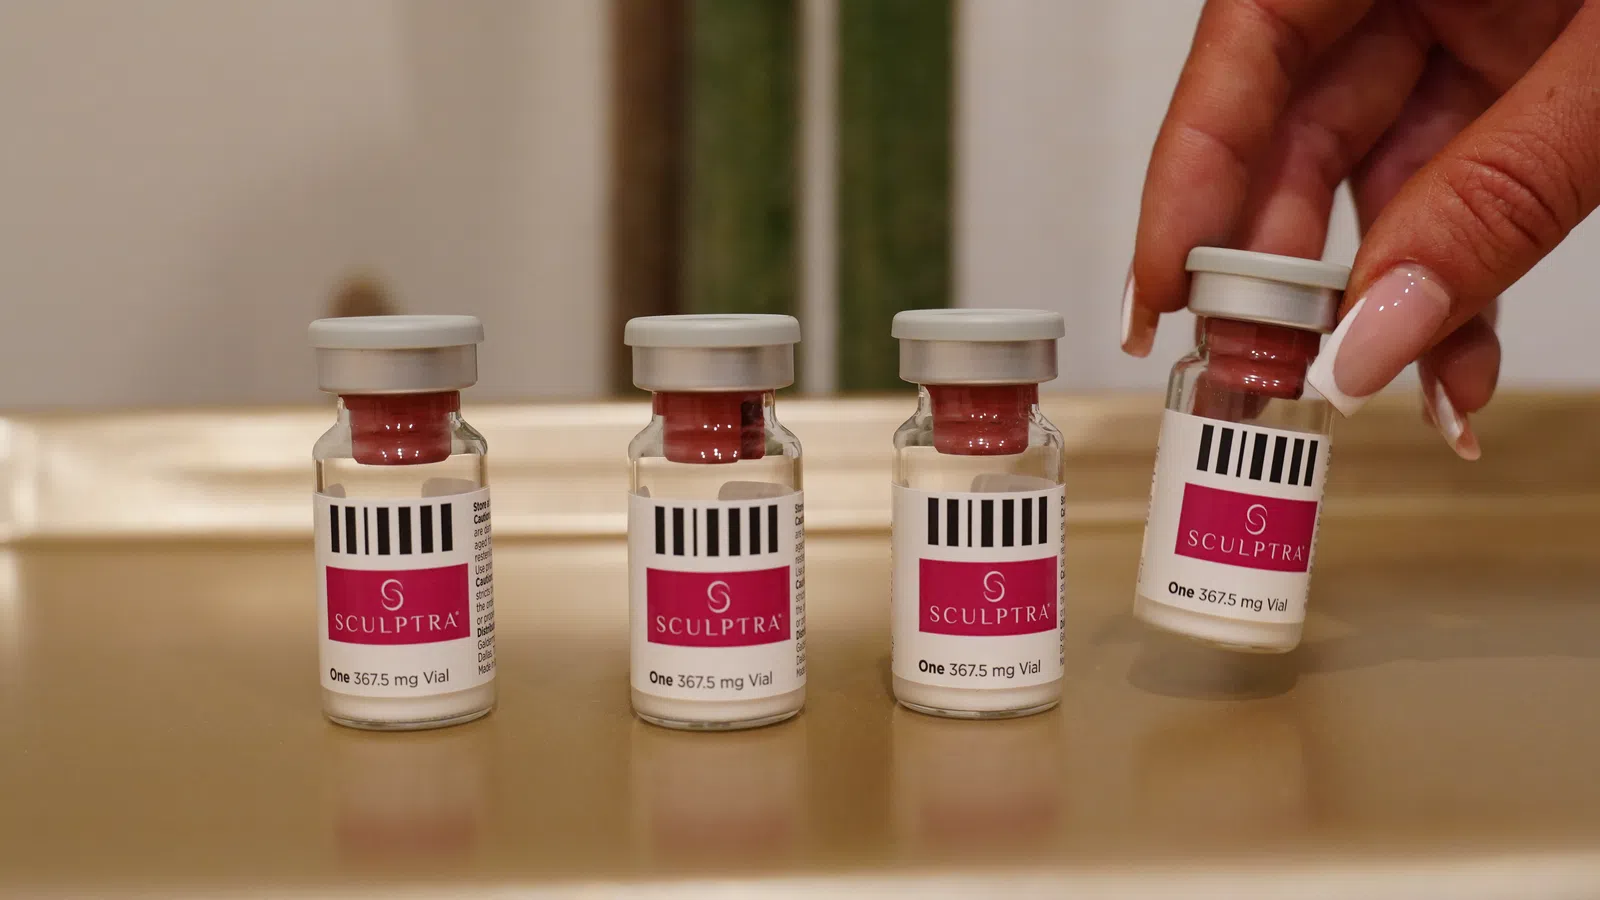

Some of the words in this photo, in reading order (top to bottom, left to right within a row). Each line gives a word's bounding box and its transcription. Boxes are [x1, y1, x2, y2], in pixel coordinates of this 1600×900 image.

[474, 527, 483, 538] are
[1168, 581, 1195, 599] One
[1198, 587, 1237, 606] 367.5
[1240, 596, 1262, 612] mg
[1266, 597, 1288, 612] Vial
[476, 602, 485, 613] the
[477, 616, 483, 625] or
[330, 667, 351, 684] One
[353, 671, 390, 686] 367.5
[394, 674, 419, 688] mg
[423, 668, 450, 684] Vial
[918, 659, 945, 675] One
[949, 663, 988, 677] 367.5
[992, 665, 1015, 679] mg
[1018, 659, 1041, 675] Vial
[650, 670, 673, 686] One
[677, 673, 715, 689] 367.5
[720, 677, 744, 691] mg
[748, 671, 773, 686] Vial
